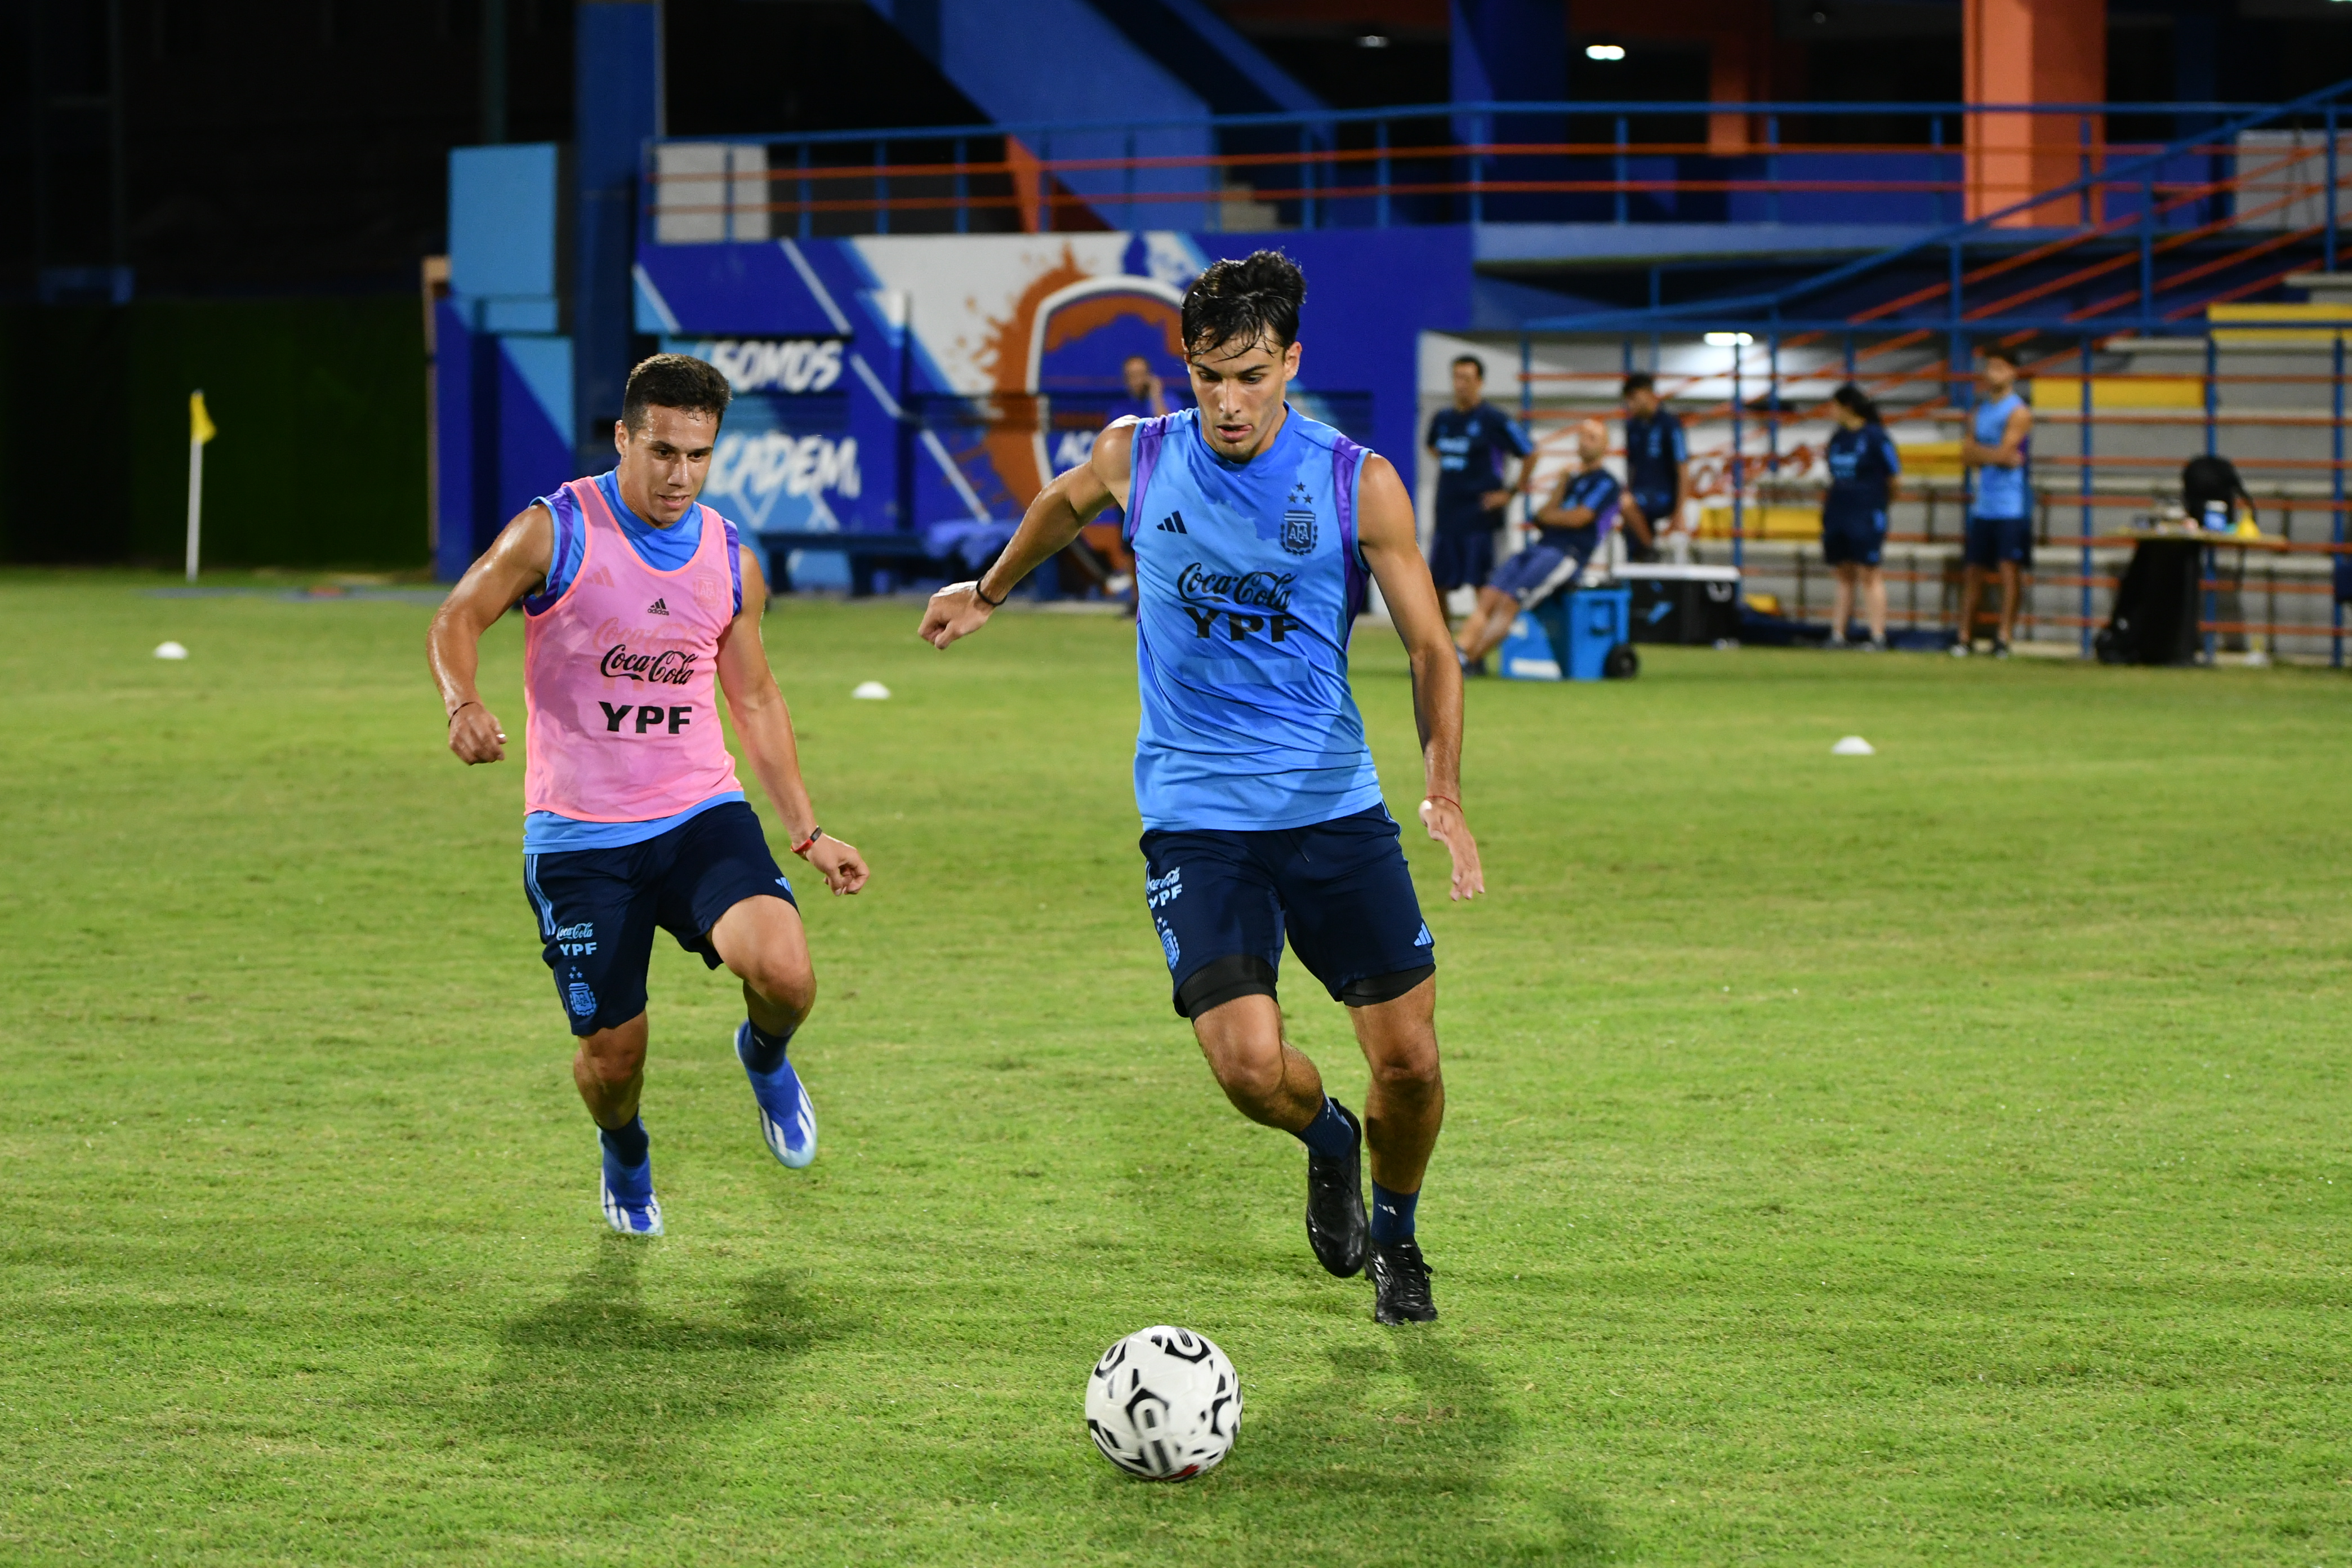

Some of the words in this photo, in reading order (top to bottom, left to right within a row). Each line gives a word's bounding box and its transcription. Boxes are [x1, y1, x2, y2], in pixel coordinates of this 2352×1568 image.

[1288, 522, 1309, 544] AFA
[1177, 562, 1298, 611] Coca-Cola
[1182, 606, 1298, 643] YPF
[600, 644, 699, 685] Coca-Cola
[598, 701, 692, 734] YPF
[1148, 883, 1183, 910] YPF
[556, 922, 593, 941] Coca-Cola
[559, 942, 597, 956] YPF
